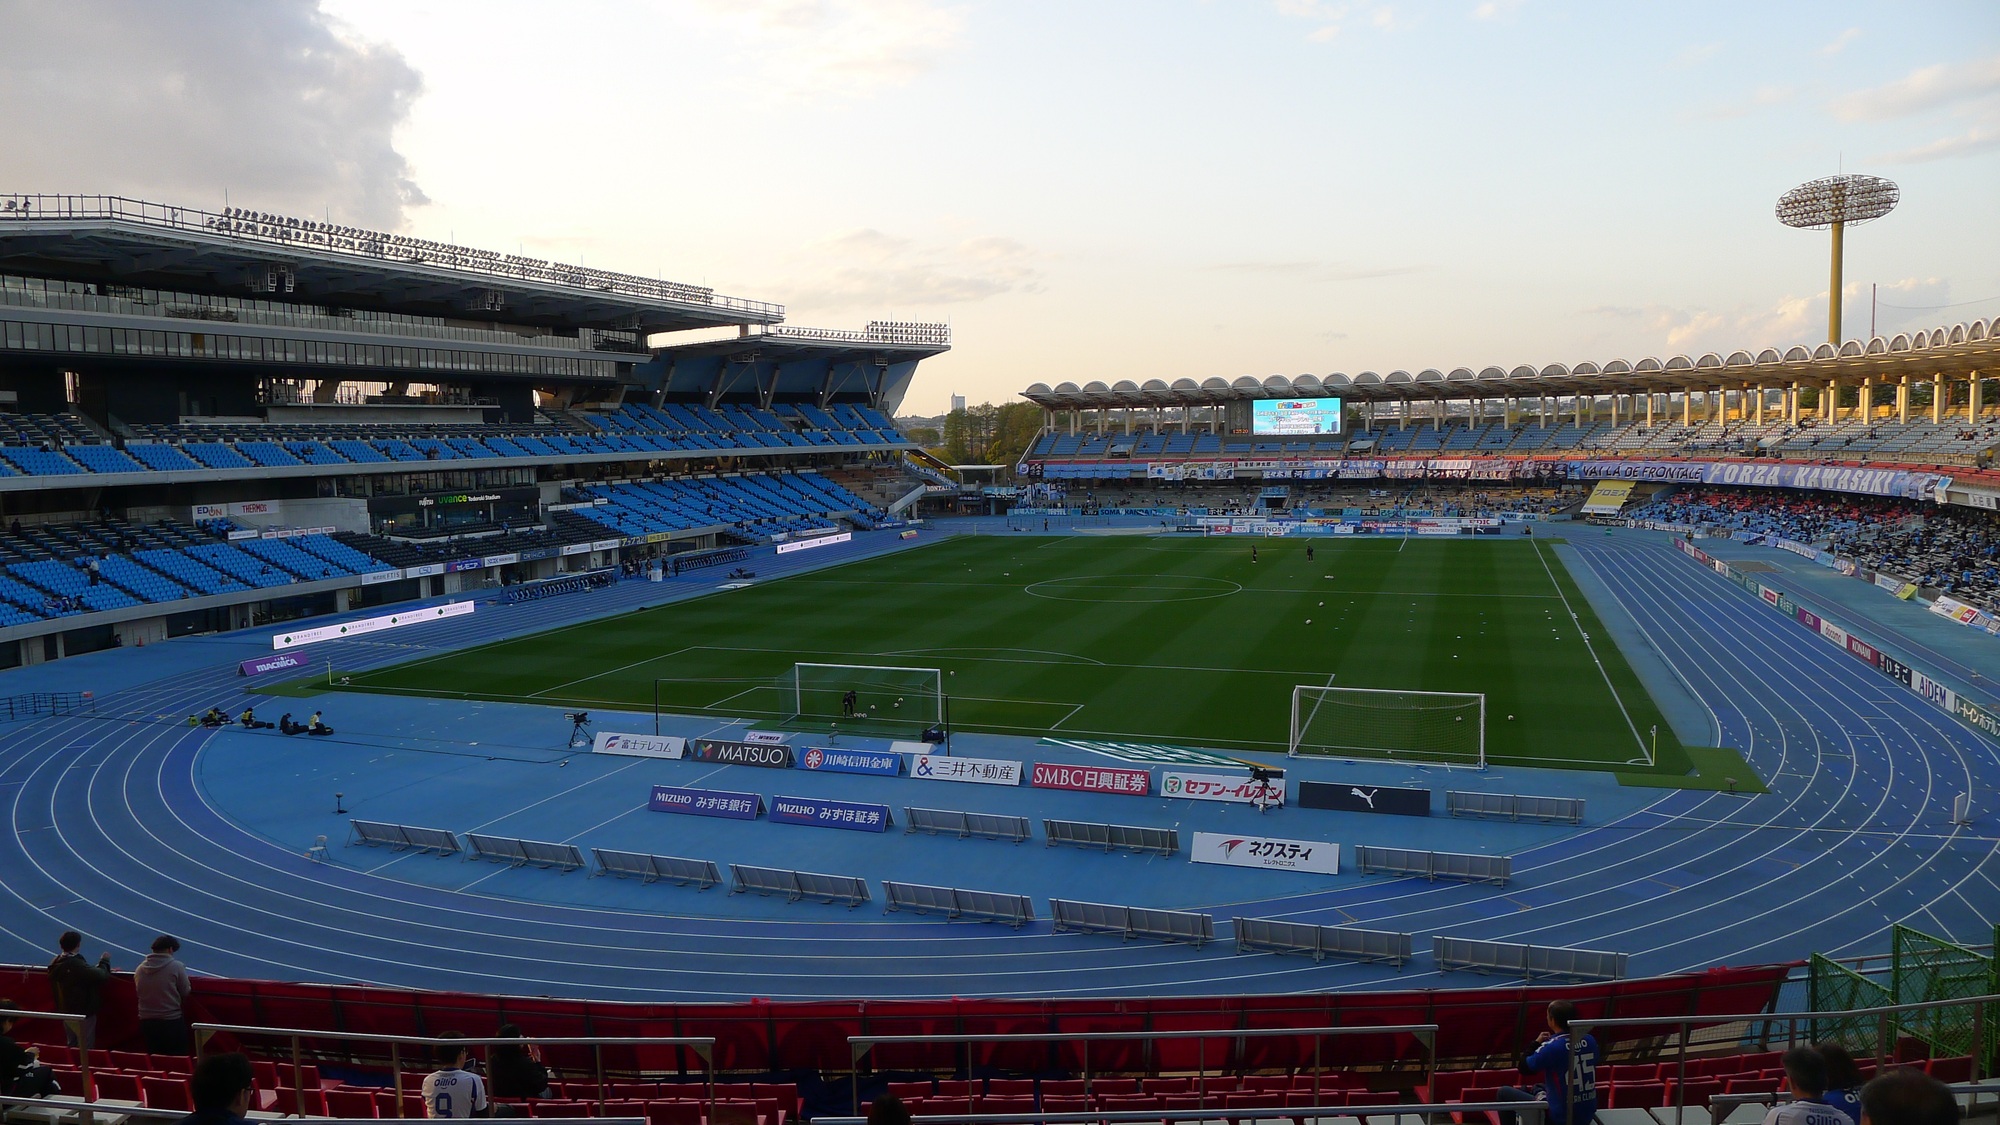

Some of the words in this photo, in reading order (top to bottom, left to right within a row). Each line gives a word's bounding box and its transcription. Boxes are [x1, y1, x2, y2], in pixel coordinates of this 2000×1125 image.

[1624, 466, 1640, 477] DE
[1642, 466, 1704, 479] FRONTALE
[1709, 463, 1781, 485] FORZA
[1793, 466, 1896, 494] KAWASAKI
[242, 504, 267, 513] THERMOS
[438, 495, 467, 504] uvance
[1825, 625, 1842, 643] docomo
[1851, 641, 1871, 660] KONAMI
[1886, 659, 1908, 684] いちご
[621, 739, 672, 752] 富士テレコム
[717, 745, 784, 764] MATSUO
[824, 754, 893, 770] 川崎信用金庫
[936, 761, 1015, 780] 三井不動産
[1034, 767, 1146, 792] SMBC日興証券
[655, 792, 692, 804] MIZUHO
[695, 796, 752, 813] みずほ銀行
[776, 803, 815, 815] MIZUHO
[819, 807, 880, 825] みずほ証券
[1248, 841, 1313, 861] ネクスティ
[1263, 859, 1296, 867] エレクトロニクス
[435, 1093, 453, 1119] 9
